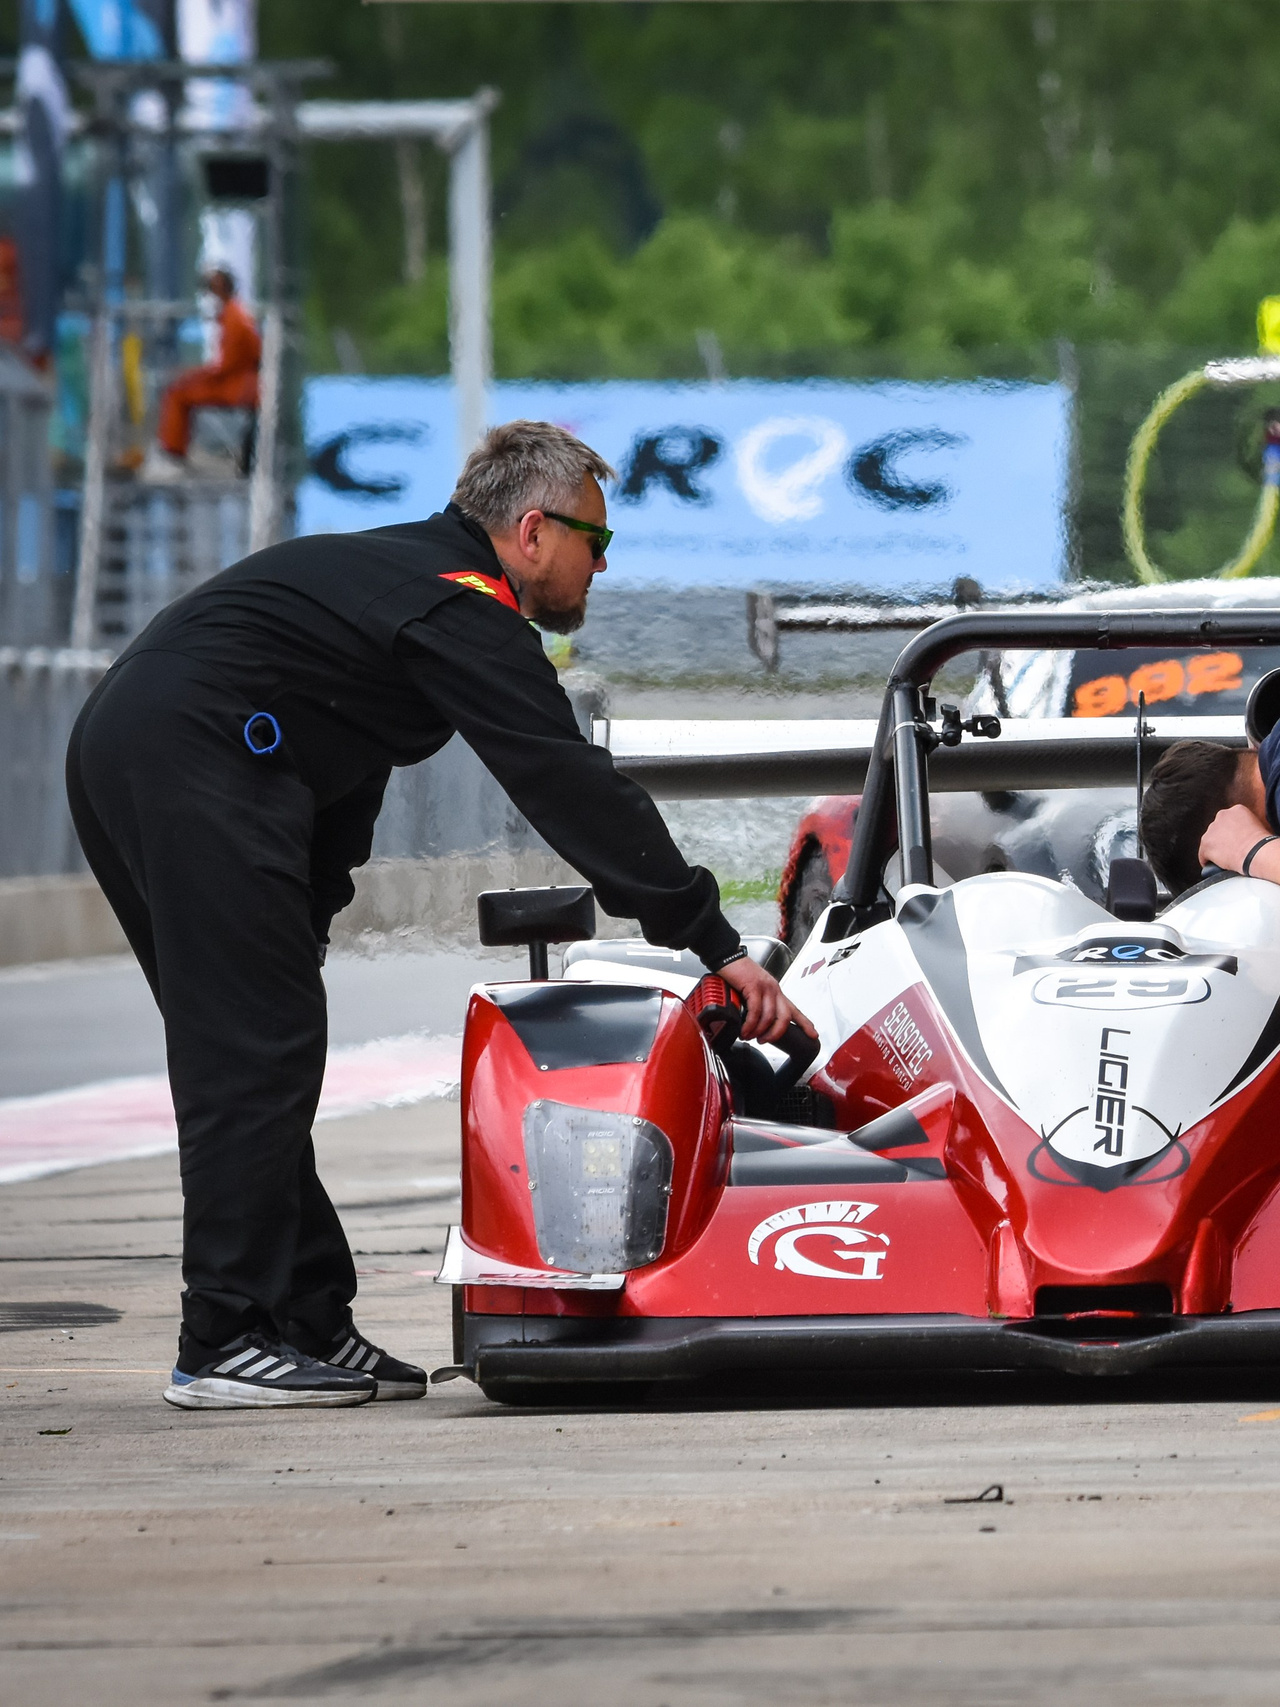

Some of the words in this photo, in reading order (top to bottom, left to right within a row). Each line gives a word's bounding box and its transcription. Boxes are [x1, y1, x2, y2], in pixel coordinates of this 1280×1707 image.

[1072, 651, 1243, 717] 992
[1056, 977, 1189, 999] 29
[872, 1030, 892, 1061] sensing
[892, 1063, 914, 1092] control
[883, 1001, 933, 1076] SENSOTEC
[1093, 1027, 1132, 1157] LIGIER
